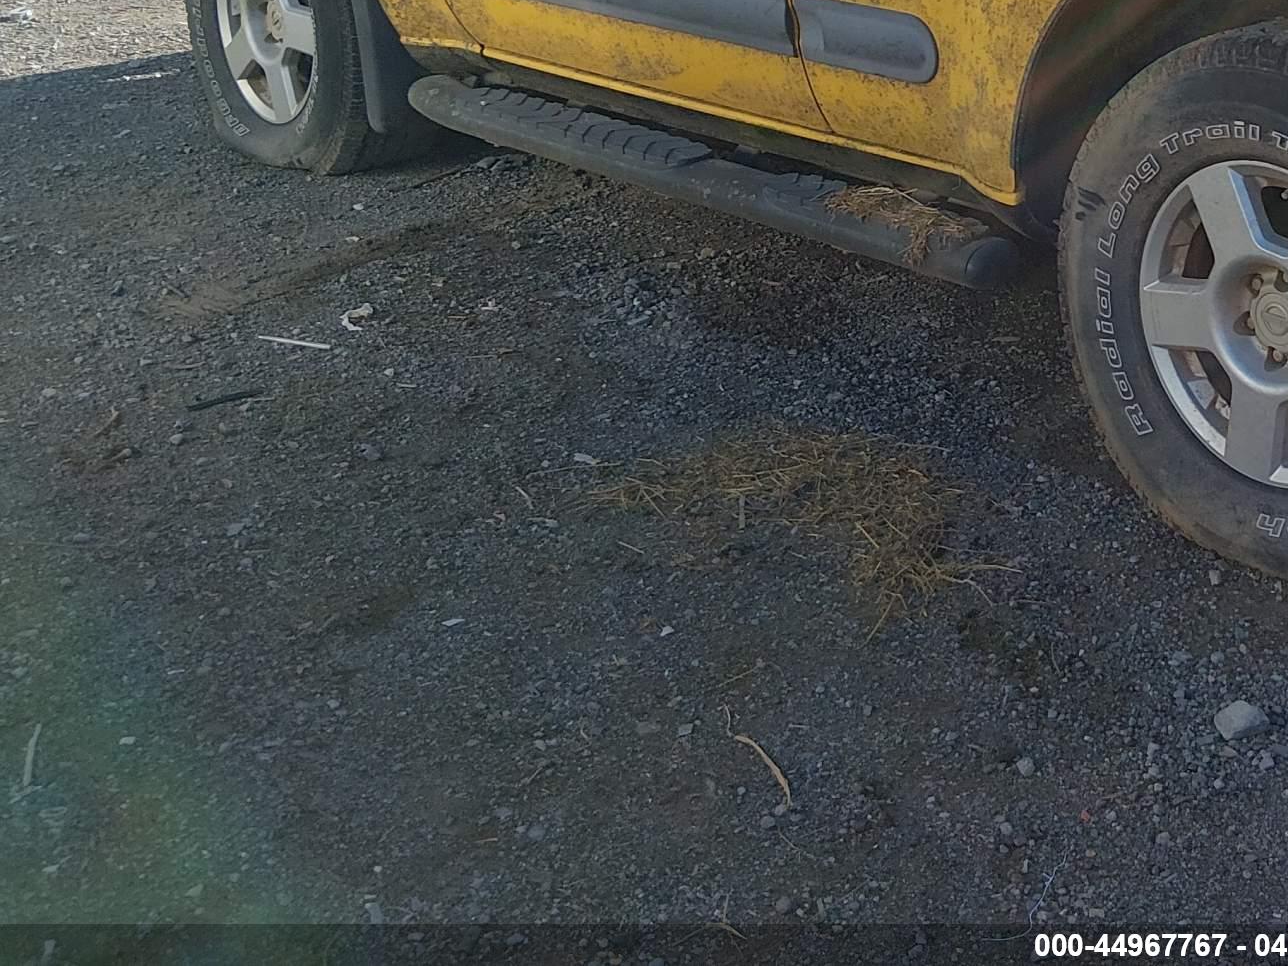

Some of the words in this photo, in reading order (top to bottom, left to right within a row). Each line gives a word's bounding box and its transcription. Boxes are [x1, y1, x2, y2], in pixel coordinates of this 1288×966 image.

[1159, 120, 1261, 155] Trail
[1097, 152, 1160, 259] Long
[1095, 267, 1155, 436] Radial
